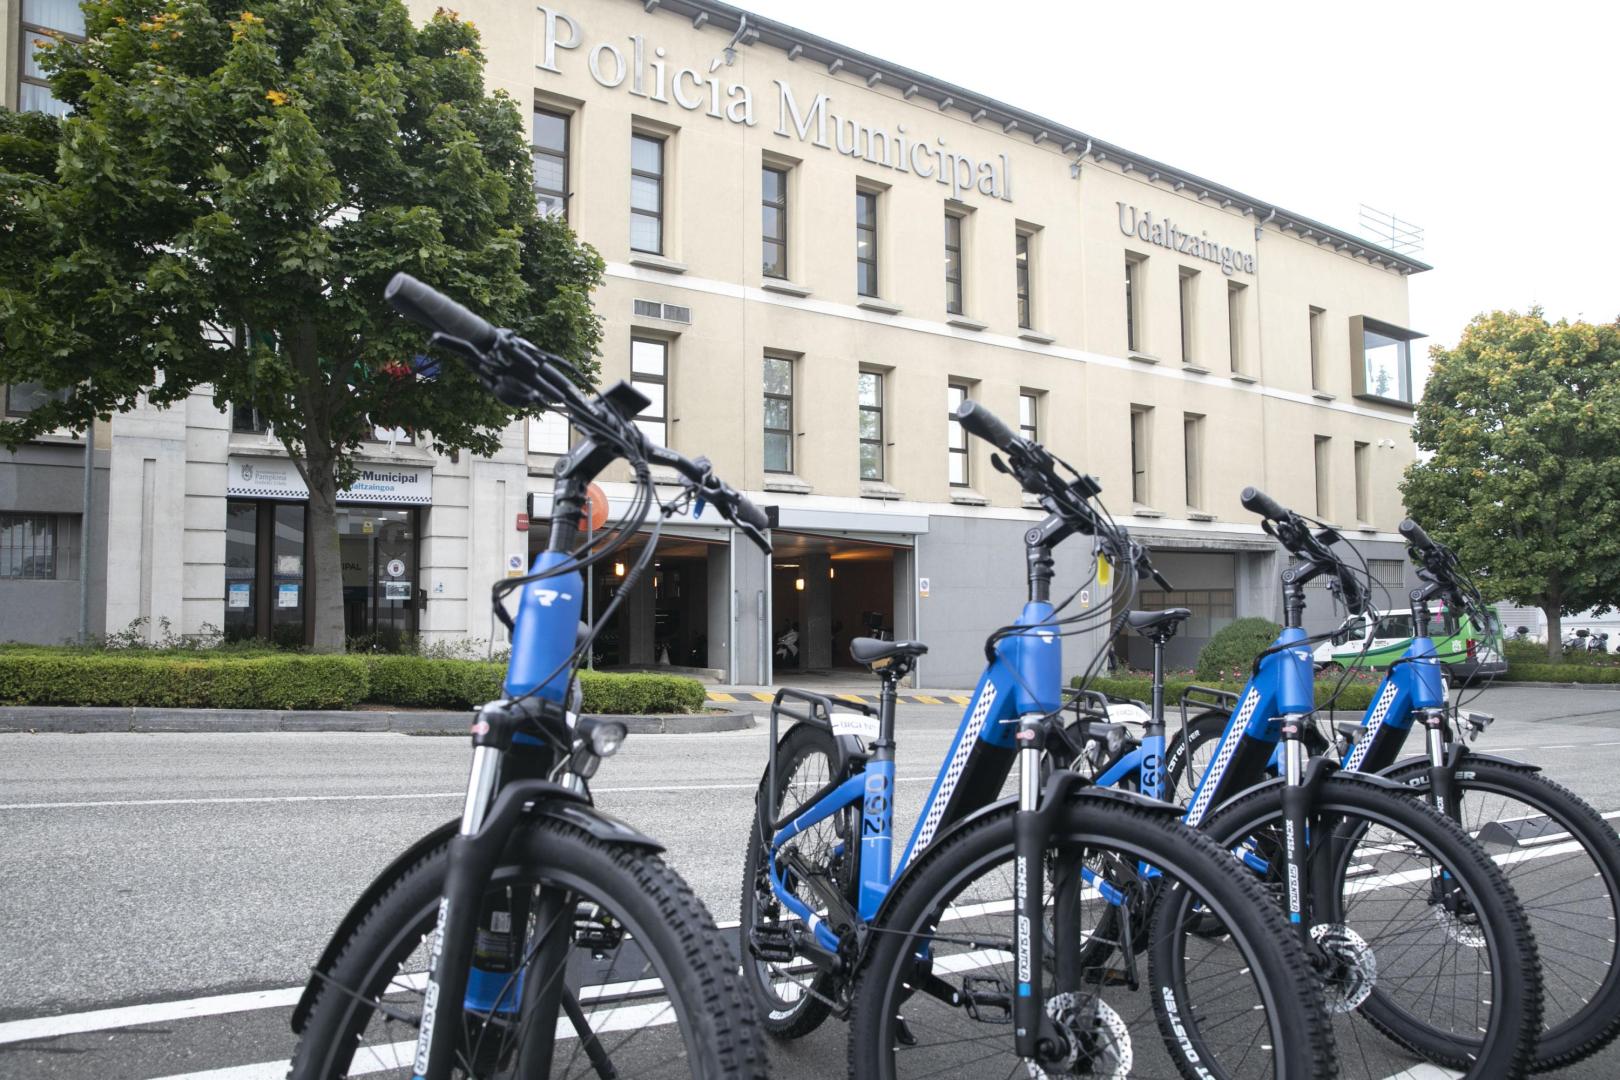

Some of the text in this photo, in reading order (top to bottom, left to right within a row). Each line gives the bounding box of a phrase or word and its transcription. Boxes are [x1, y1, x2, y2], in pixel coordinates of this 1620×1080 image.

[535, 6, 1013, 203] Policía Municipal
[1116, 201, 1256, 276] Udaltzaingoa
[362, 470, 418, 484] Municipal
